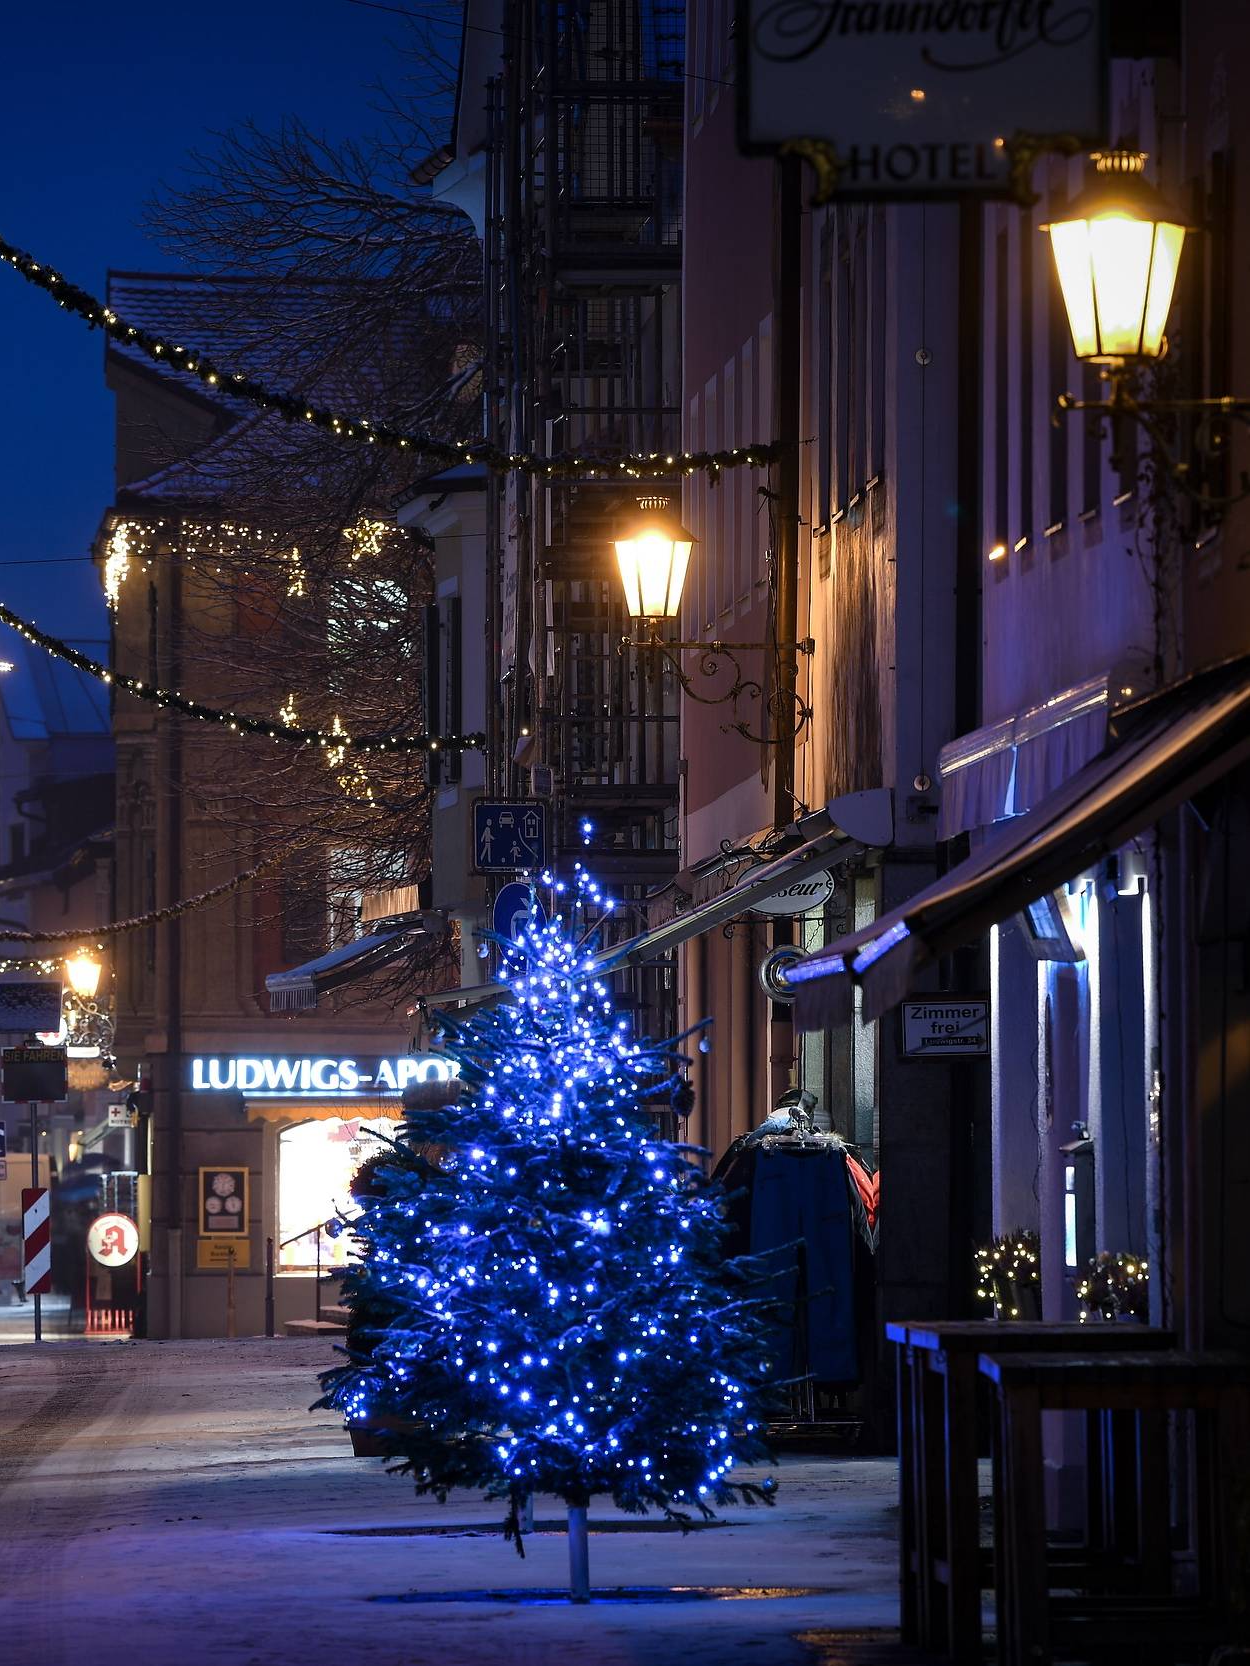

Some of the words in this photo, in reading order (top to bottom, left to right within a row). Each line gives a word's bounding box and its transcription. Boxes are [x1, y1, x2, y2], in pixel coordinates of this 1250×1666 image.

[852, 145, 997, 181] HOTEL
[911, 1006, 979, 1019] Zimmer
[931, 1021, 960, 1034] frei
[4, 1050, 21, 1062] SIE
[23, 1050, 64, 1062] FAHREN
